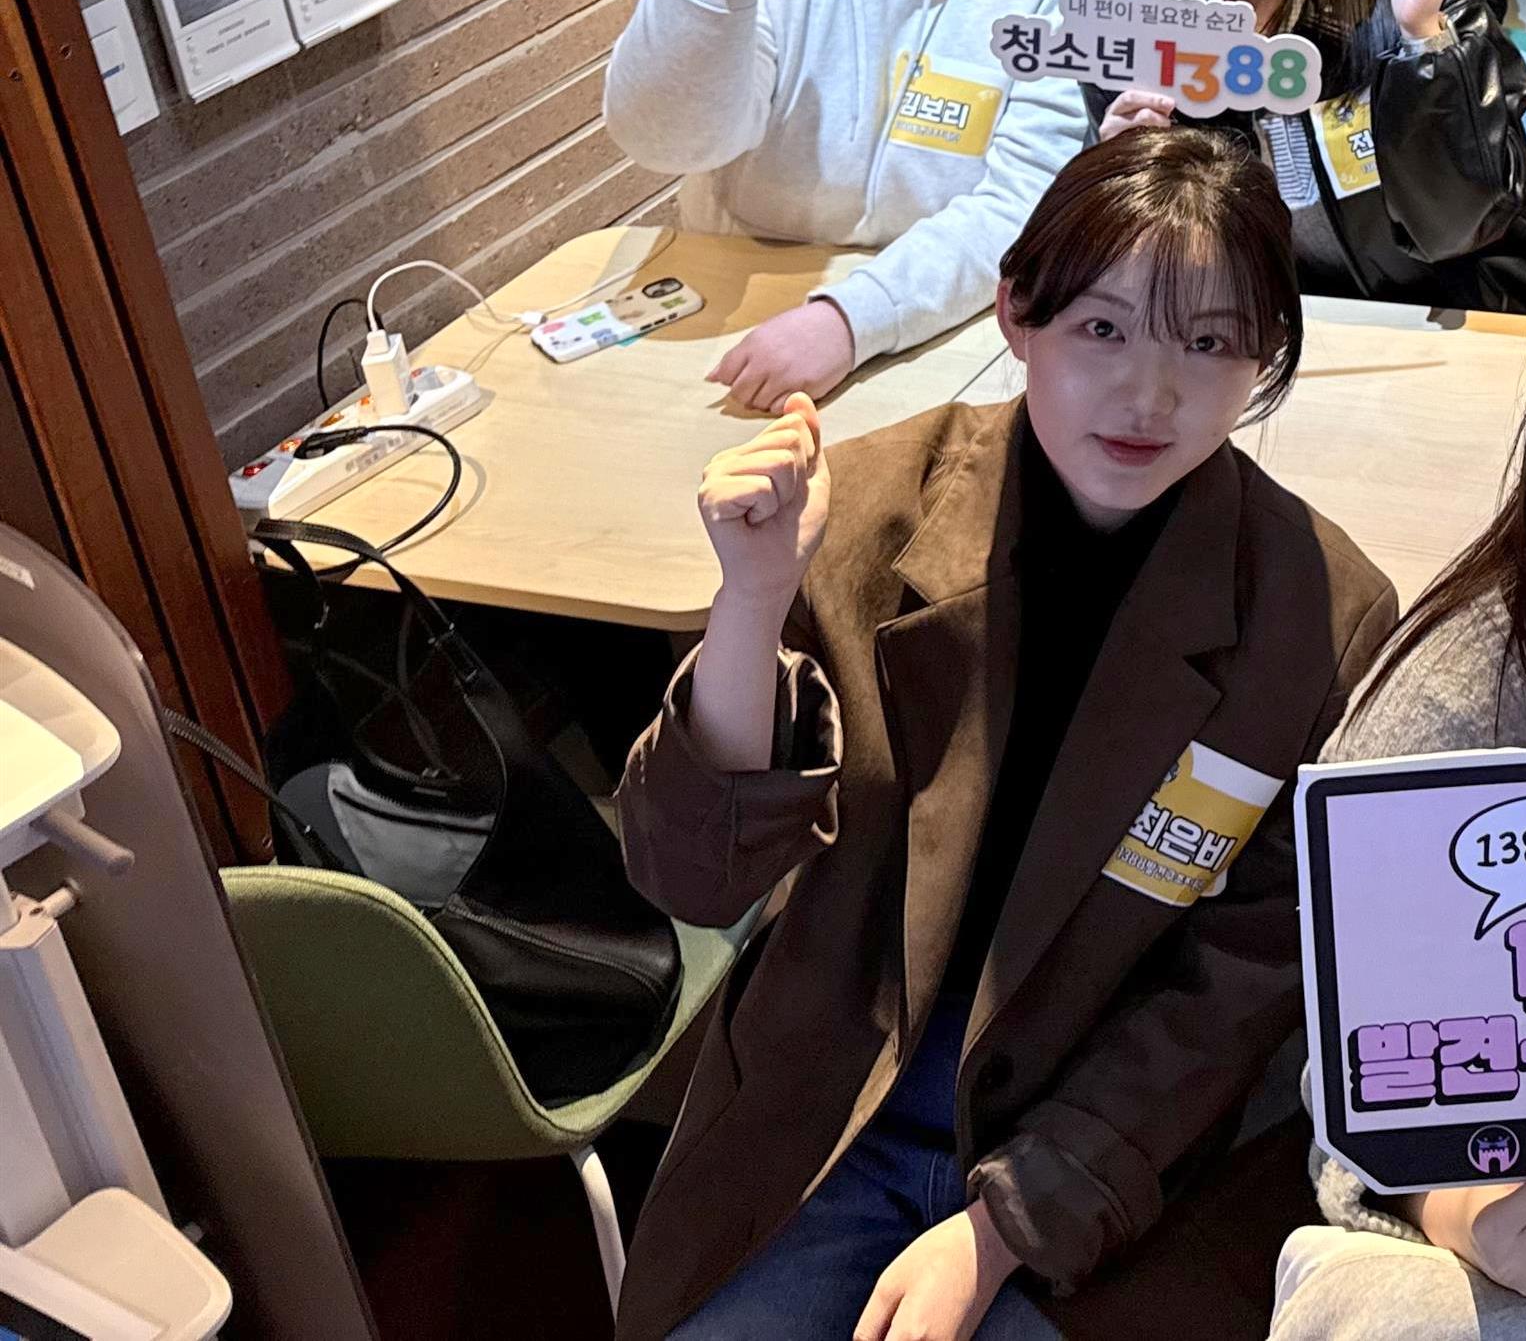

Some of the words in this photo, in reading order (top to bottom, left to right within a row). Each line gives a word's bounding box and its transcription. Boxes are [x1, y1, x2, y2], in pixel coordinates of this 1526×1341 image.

[1095, 0, 1133, 22] 편이
[1140, 4, 1200, 29] 필요한
[1205, 10, 1246, 33] 순간
[1001, 23, 1136, 83] 청소년
[1154, 40, 1307, 102] 1388
[900, 88, 971, 130] 김보리
[1128, 798, 1238, 873] 최은비
